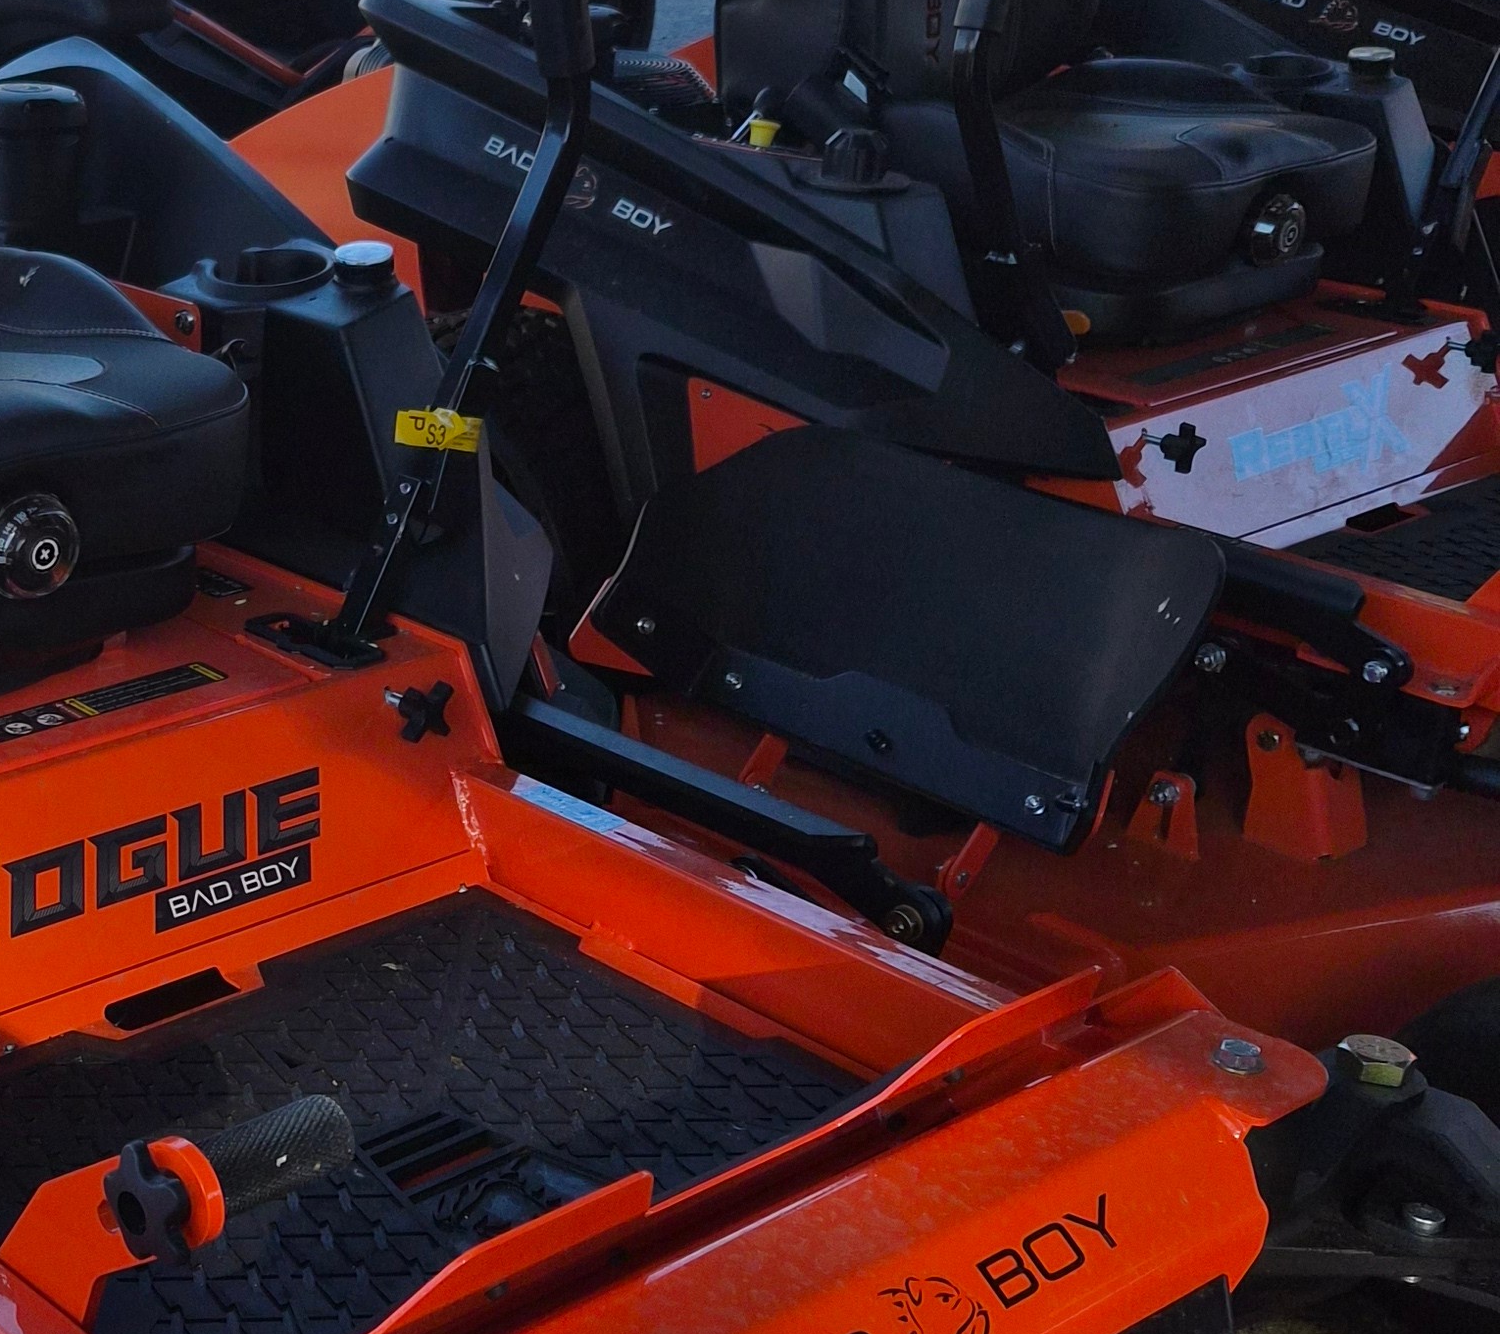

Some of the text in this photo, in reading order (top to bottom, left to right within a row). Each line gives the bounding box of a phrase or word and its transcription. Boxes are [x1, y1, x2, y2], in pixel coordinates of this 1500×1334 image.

[1372, 21, 1426, 46] BOY
[483, 135, 673, 235] BAD BOY
[168, 856, 299, 918] BAD BOY
[976, 1193, 1117, 1309] BOY
